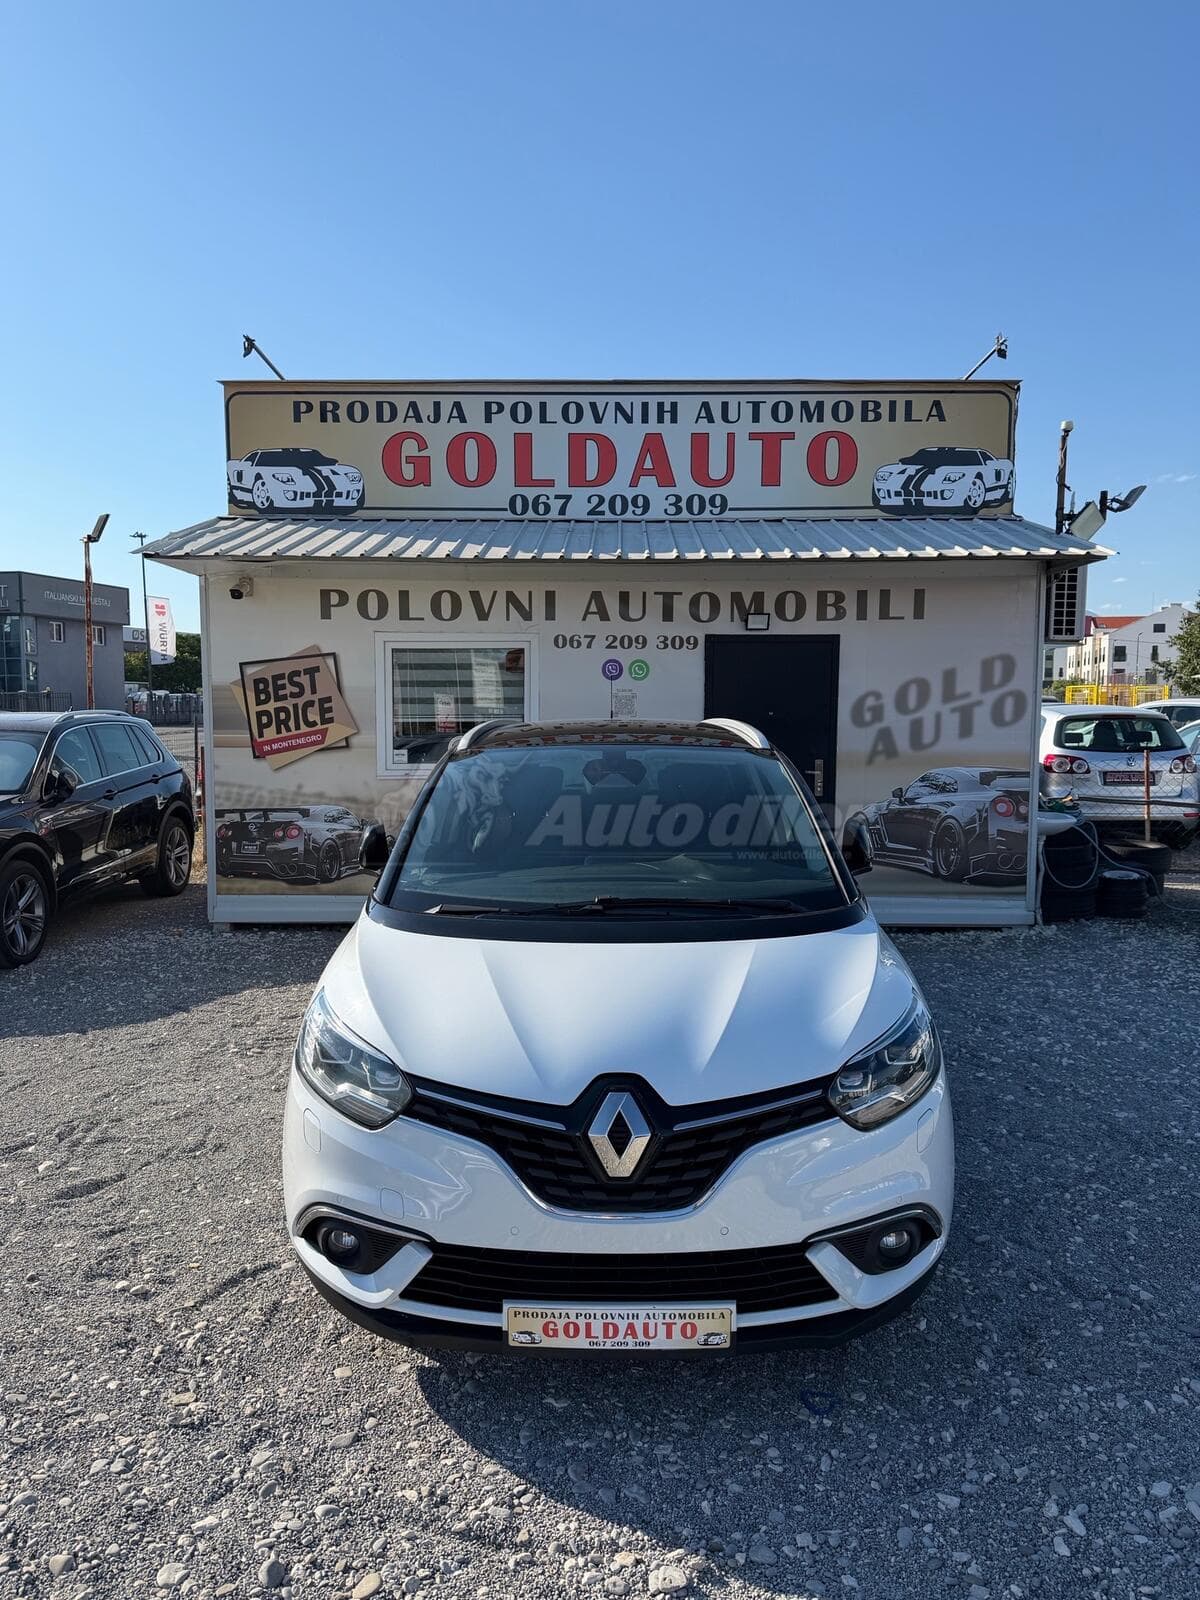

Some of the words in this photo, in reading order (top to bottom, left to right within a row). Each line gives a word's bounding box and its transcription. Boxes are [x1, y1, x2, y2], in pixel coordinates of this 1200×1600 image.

[292, 399, 468, 424] PRODAJA
[484, 399, 679, 425] POLOVNIH
[694, 398, 947, 424] AUTOMOBILA
[381, 430, 859, 488] GOLDAUTO
[508, 493, 573, 516] 067
[586, 493, 651, 516] 209
[664, 493, 729, 516] 309
[320, 588, 556, 622] POLOVNI
[581, 588, 926, 623] AUTOMOBILI
[553, 634, 597, 650] 067
[604, 634, 648, 650] 209
[656, 634, 699, 651] 309
[253, 666, 319, 706] BEST
[850, 652, 1017, 728] GOLD
[255, 696, 334, 738] PRICE
[866, 689, 1028, 766] AUTO
[272, 735, 322, 750] MONTENEGRO
[513, 1310, 571, 1320] PRODAJA
[575, 1311, 640, 1321] POLOVNIH
[644, 1311, 726, 1321] AUTOMOBILA
[542, 1320, 699, 1340] GOLDAUTO
[588, 1340, 608, 1348] 067
[610, 1340, 629, 1348] 209
[631, 1340, 651, 1348] 309
